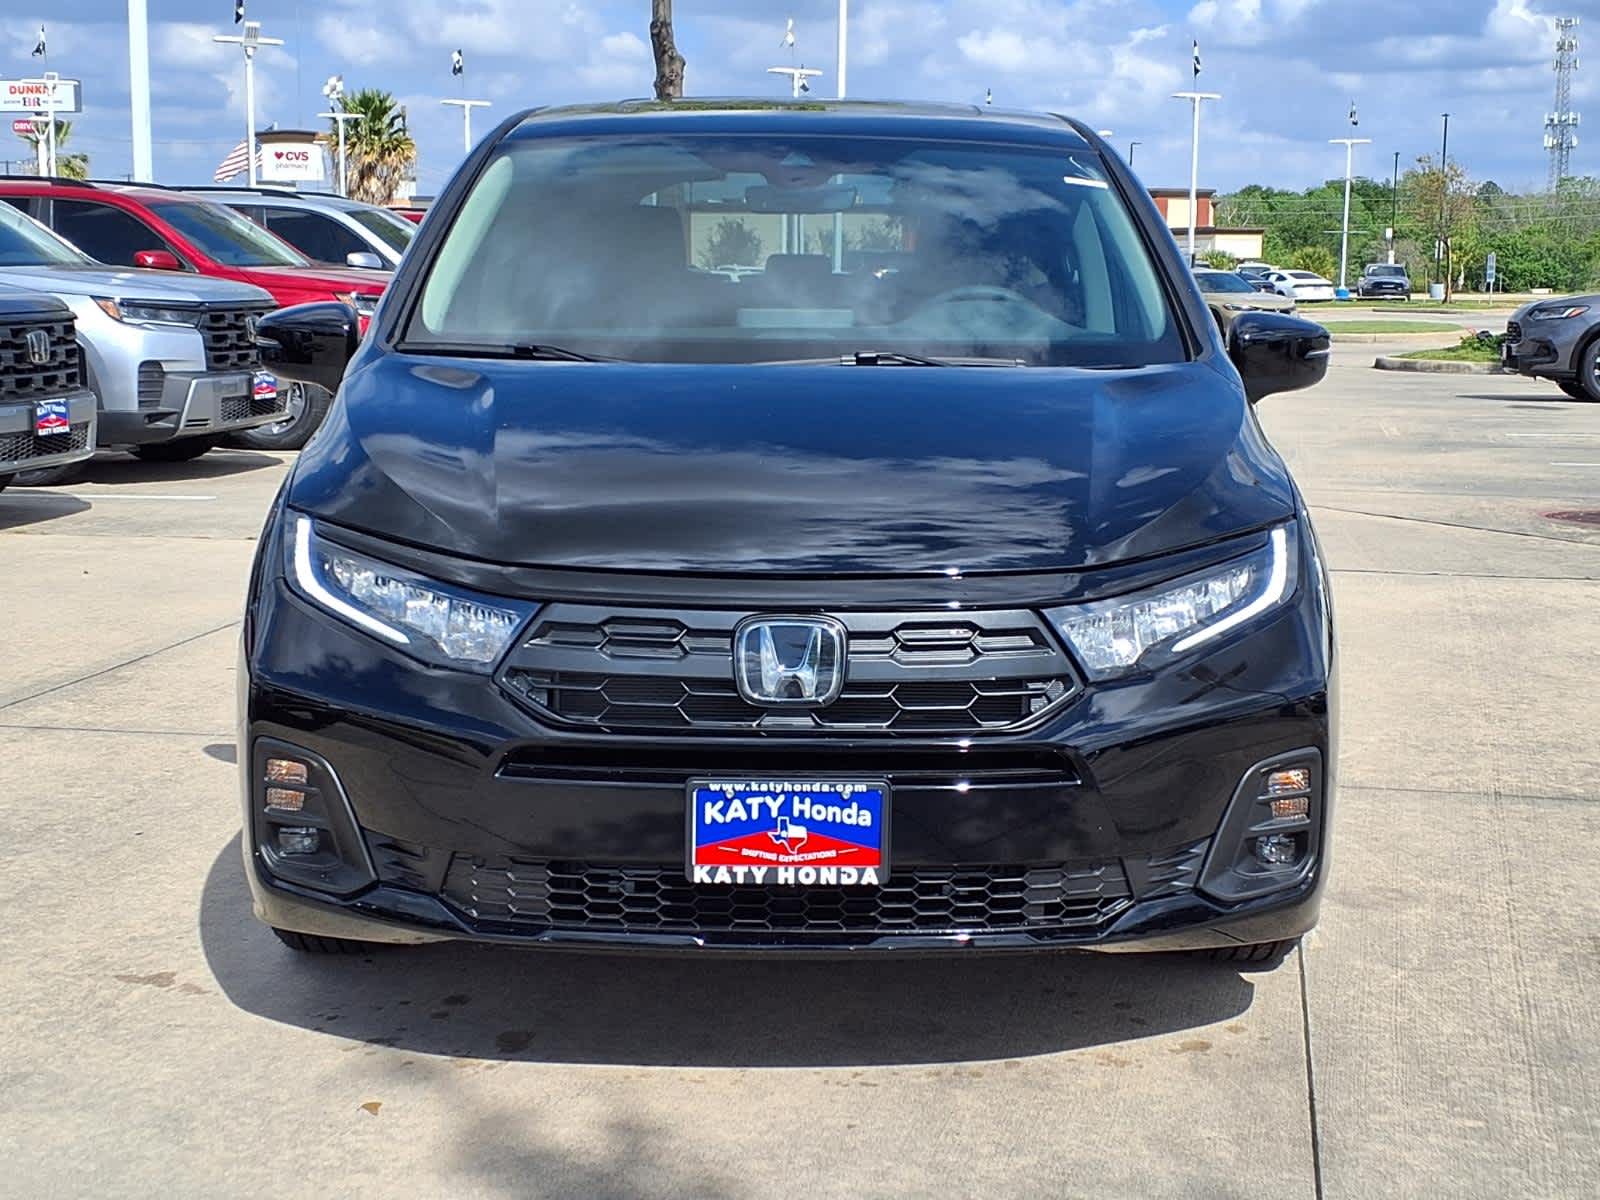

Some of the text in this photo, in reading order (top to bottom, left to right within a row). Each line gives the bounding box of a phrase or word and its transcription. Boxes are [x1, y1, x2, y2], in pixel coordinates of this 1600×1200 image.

[285, 151, 309, 161] CVS
[275, 163, 308, 172] pharmacy
[708, 782, 867, 793] www.katyhonda.com
[704, 794, 872, 828] KATY Honda
[693, 865, 879, 885] KATY HONDA
